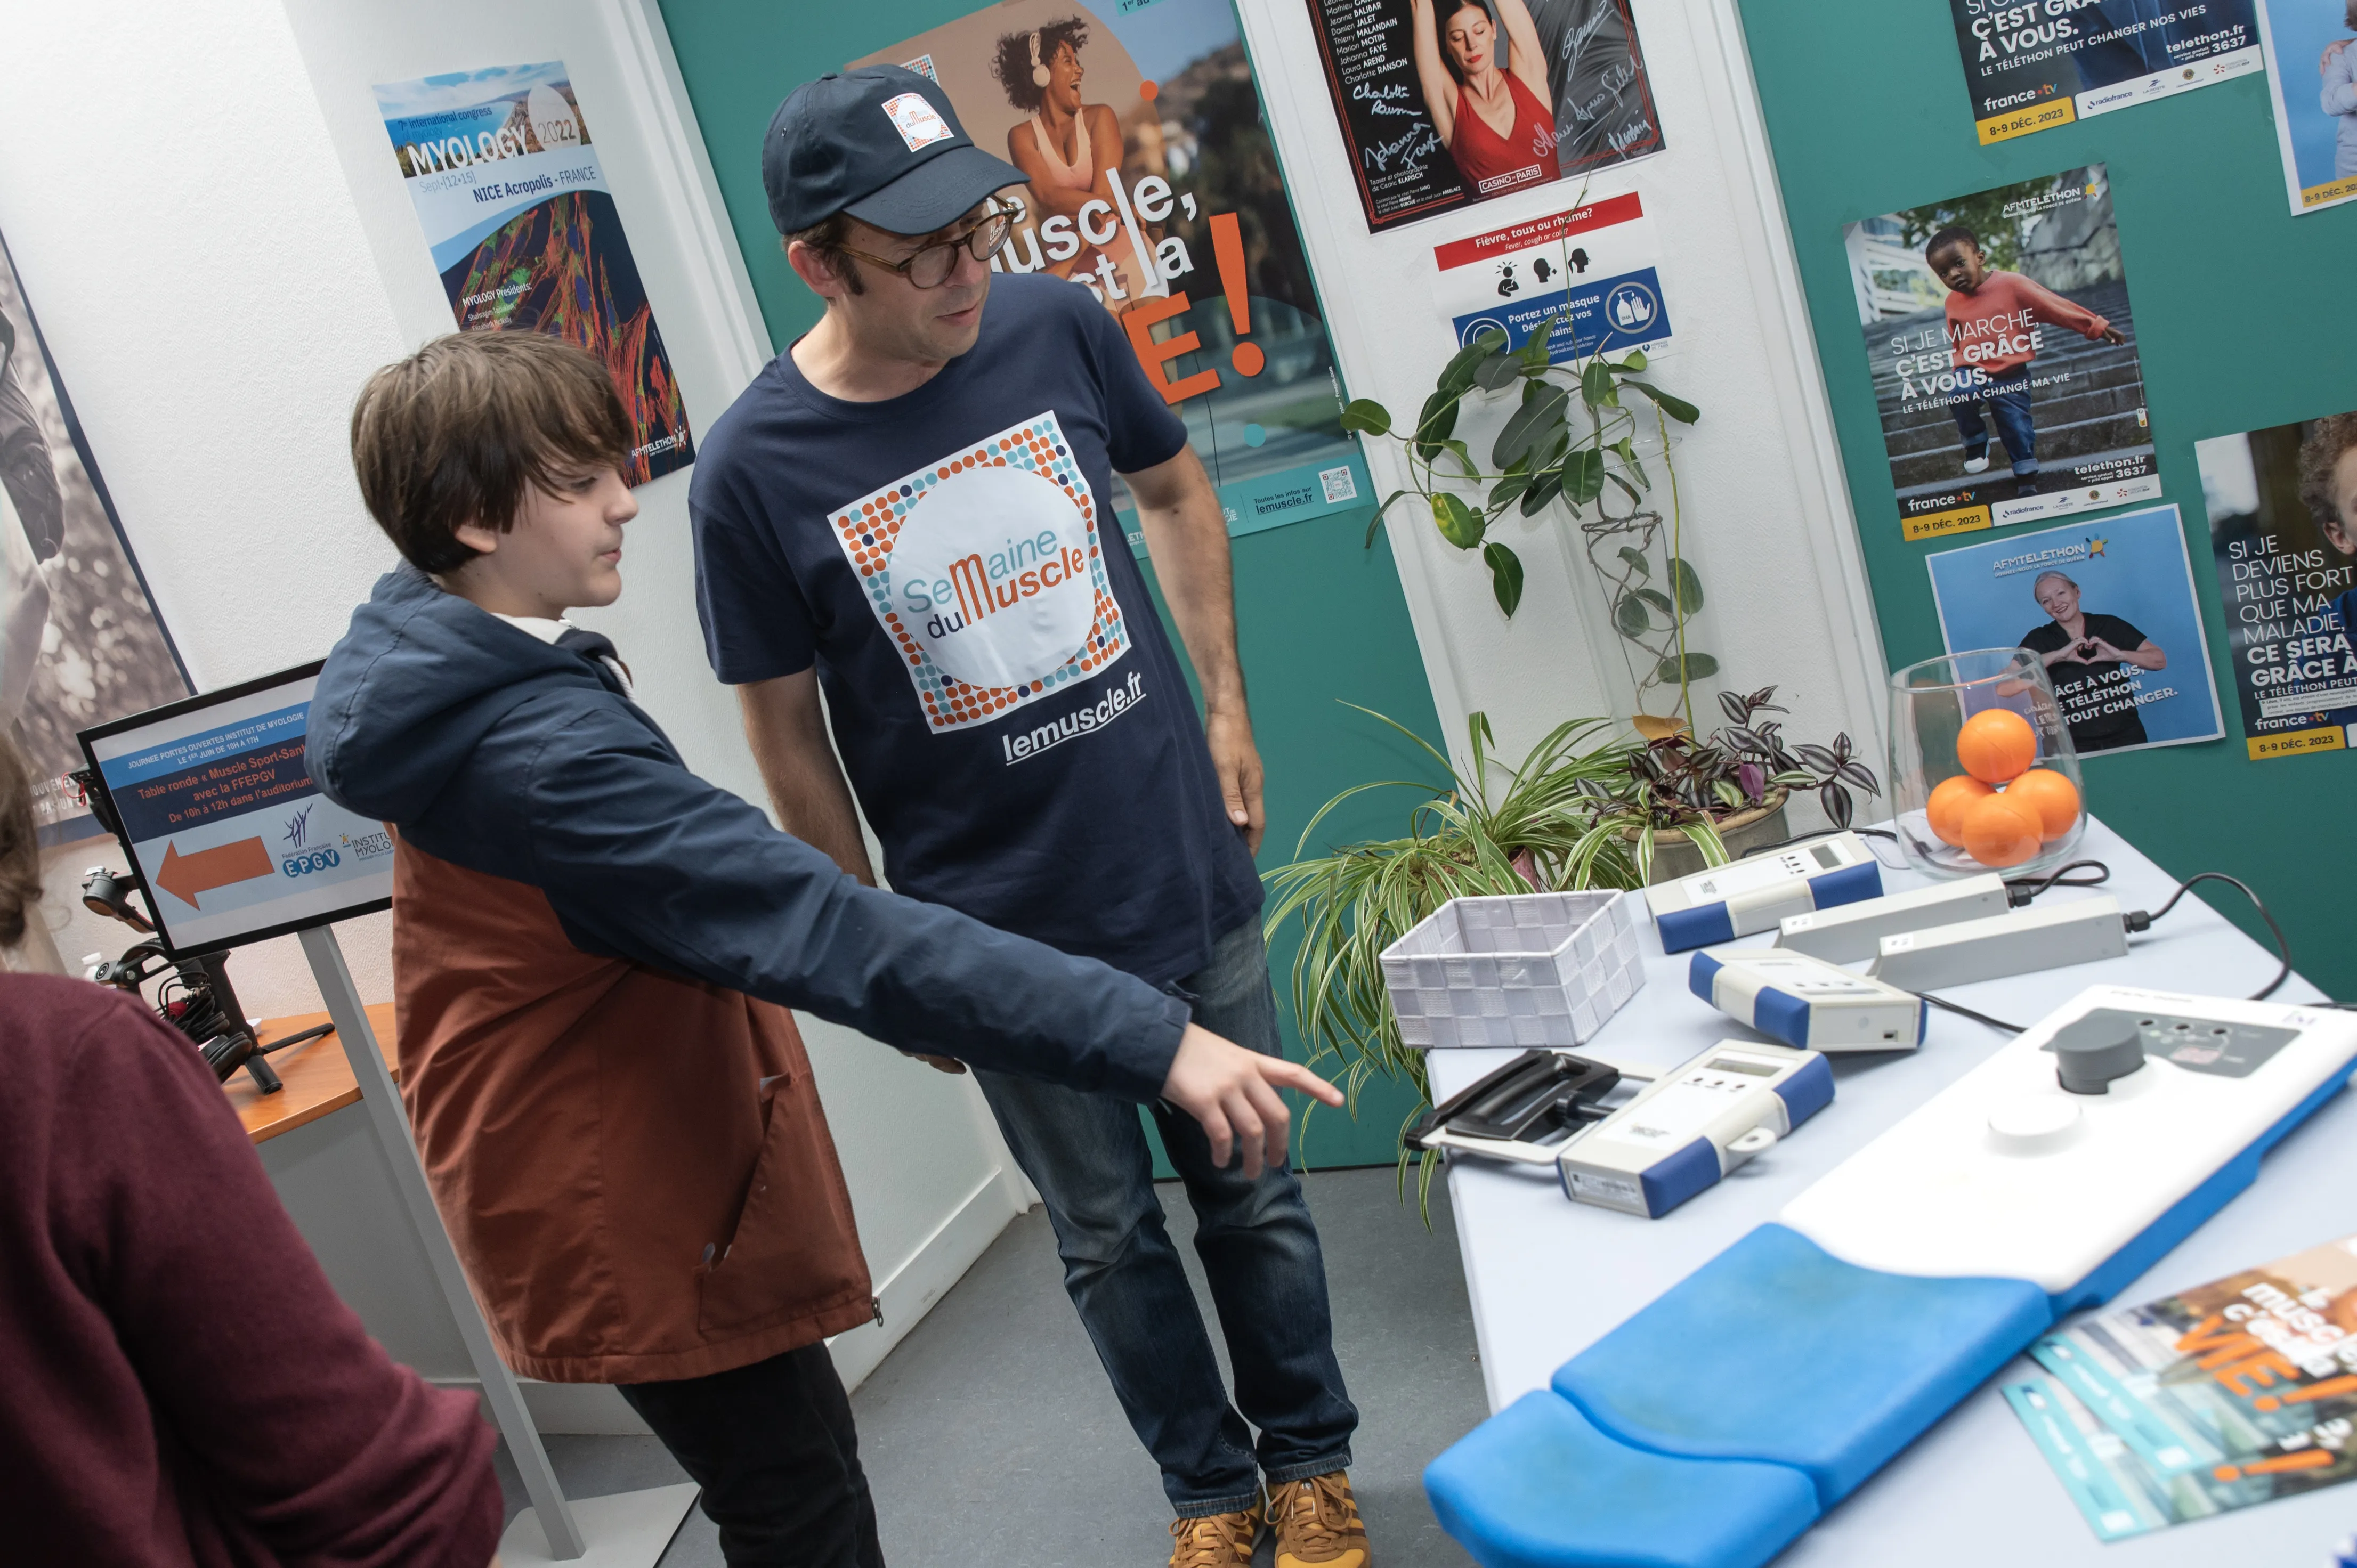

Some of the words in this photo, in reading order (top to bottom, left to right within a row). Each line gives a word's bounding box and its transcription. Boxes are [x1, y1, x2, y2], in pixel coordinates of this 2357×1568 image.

[1330, 14, 1353, 26] Jeanne
[1354, 2, 1382, 18] BALIBAR
[1331, 24, 1355, 36] Damien
[1357, 14, 1376, 27] JALET
[1333, 34, 1355, 46] Thierry
[1356, 17, 1398, 38] MALANDAIN
[1336, 43, 1360, 55] Marion
[1361, 33, 1385, 47] MOTIN
[1979, 36, 1997, 62] À
[1999, 18, 2079, 54] VOUS.
[1981, 66, 1993, 77] LE
[1996, 48, 2053, 72] TÉLÉTHON
[2056, 39, 2084, 55] PEUT
[2087, 22, 2146, 46] CHANGER
[2150, 13, 2176, 29] NOS
[2179, 4, 2206, 20] VIES
[2166, 24, 2244, 53] telethon.fr
[2212, 35, 2247, 53] 3637
[1340, 52, 1368, 66] Johanna
[1369, 43, 1388, 56] FAYE
[1342, 65, 1361, 75] Laura
[1363, 55, 1385, 68] AREND
[1344, 69, 1376, 84] Charlotte
[1377, 58, 1407, 74] RANSON
[2096, 91, 2133, 105] radiofrance
[409, 111, 457, 129] international
[458, 107, 492, 120] congress
[1989, 124, 2008, 136] 8-9
[2011, 117, 2036, 131] DÉC.
[2038, 109, 2064, 123] 2023
[407, 125, 529, 176] MYOLOGY
[538, 120, 577, 143] 2022
[473, 184, 504, 202] NICE
[505, 175, 553, 196] Acropolis
[559, 166, 596, 185] FRANCE
[1398, 172, 1423, 184] KLAPISCH
[1482, 176, 1511, 190] CASINO
[1517, 167, 1538, 180] PARIS
[2305, 193, 2320, 203] 8-9
[2322, 188, 2343, 198] DÉC.
[2345, 184, 2357, 192] 20
[990, 167, 1197, 287] uscle,
[1475, 233, 1509, 248] Fièvre,
[1511, 226, 1535, 238] toux
[1537, 221, 1551, 231] ou
[1553, 207, 1592, 226] rhume?
[1505, 241, 1522, 251] Fever,
[1524, 236, 1542, 246] cough
[462, 290, 496, 307] MYOLOGY
[496, 283, 532, 298] Presidents:
[1508, 309, 1542, 324] Portez
[1543, 305, 1557, 315] un
[1559, 295, 1600, 313] masque
[1575, 309, 1592, 321] vos
[1891, 336, 1909, 355] SI
[1915, 329, 1937, 350] JE
[1941, 308, 2039, 344] MARCHE,
[1963, 330, 2044, 362] GRÂCE
[1901, 378, 1918, 401] À
[1921, 367, 1993, 395] VOUS.
[1903, 404, 1914, 414] LE
[1916, 394, 1969, 411] TÉLÉTHON
[1982, 379, 2028, 397] CHANGÉ
[2032, 378, 2050, 388] MA
[2052, 373, 2070, 384] VIE
[2074, 455, 2145, 475] telethon.fr
[2116, 465, 2147, 478] 3637
[1254, 496, 1274, 505] Toutes
[1256, 493, 1313, 514] lemuscle.fr
[2010, 505, 2044, 515] radiofrance
[1913, 524, 1930, 533] 8-9
[1933, 519, 1955, 530] DÉC.
[1958, 515, 1981, 525] 2023
[2229, 540, 2247, 559] SI
[2255, 535, 2279, 555] JE
[2232, 550, 2323, 581] DEVIENS
[2235, 578, 2289, 602] PLUS
[2295, 566, 2353, 592] FORT
[2240, 599, 2287, 624] QUE
[2293, 593, 2331, 614] MA
[2243, 612, 2345, 644] MALADIE,
[2247, 644, 2280, 664] CE
[2286, 633, 2352, 658] SERA
[2086, 676, 2098, 689] À
[2098, 665, 2145, 685] VOUS,
[2251, 659, 2336, 686] GRÂCE
[2067, 680, 2142, 709] TÉLÉTHON
[2254, 691, 2266, 700] LE
[2269, 681, 2326, 697] TÉLÉTHON
[1002, 671, 1144, 763] lemuscle.fr
[2066, 706, 2100, 725] TOUT
[2103, 687, 2178, 714] CHANGER.
[128, 754, 159, 769] JOURNEE
[160, 747, 187, 760] PORTES
[188, 735, 224, 751] OUVERTES
[225, 727, 255, 741] INSTITUT
[256, 723, 266, 732] DE
[266, 712, 305, 729] MYOLOGIE
[177, 757, 188, 765] LE
[199, 749, 215, 760] JUIN
[216, 746, 226, 755] DE
[227, 741, 240, 751] 10H
[246, 736, 260, 745] 17H
[2259, 743, 2278, 752] 8-9
[2281, 738, 2306, 749] DÉC.
[2309, 735, 2334, 746] 2023
[137, 784, 166, 800] Table
[167, 776, 199, 792] ronde
[208, 762, 247, 781] Muscle
[248, 743, 305, 770] Sport-Sant
[193, 787, 218, 801] avec
[220, 783, 231, 794] la
[231, 769, 276, 791] FFEPGV
[168, 812, 182, 823] De
[184, 807, 201, 819] 10h
[204, 805, 209, 814] à
[211, 799, 228, 811] 12h
[230, 793, 254, 806] dans
[281, 848, 307, 859] Fédération
[308, 842, 331, 854] Française
[351, 832, 390, 848] INSTITU
[285, 850, 337, 877] EPGV
